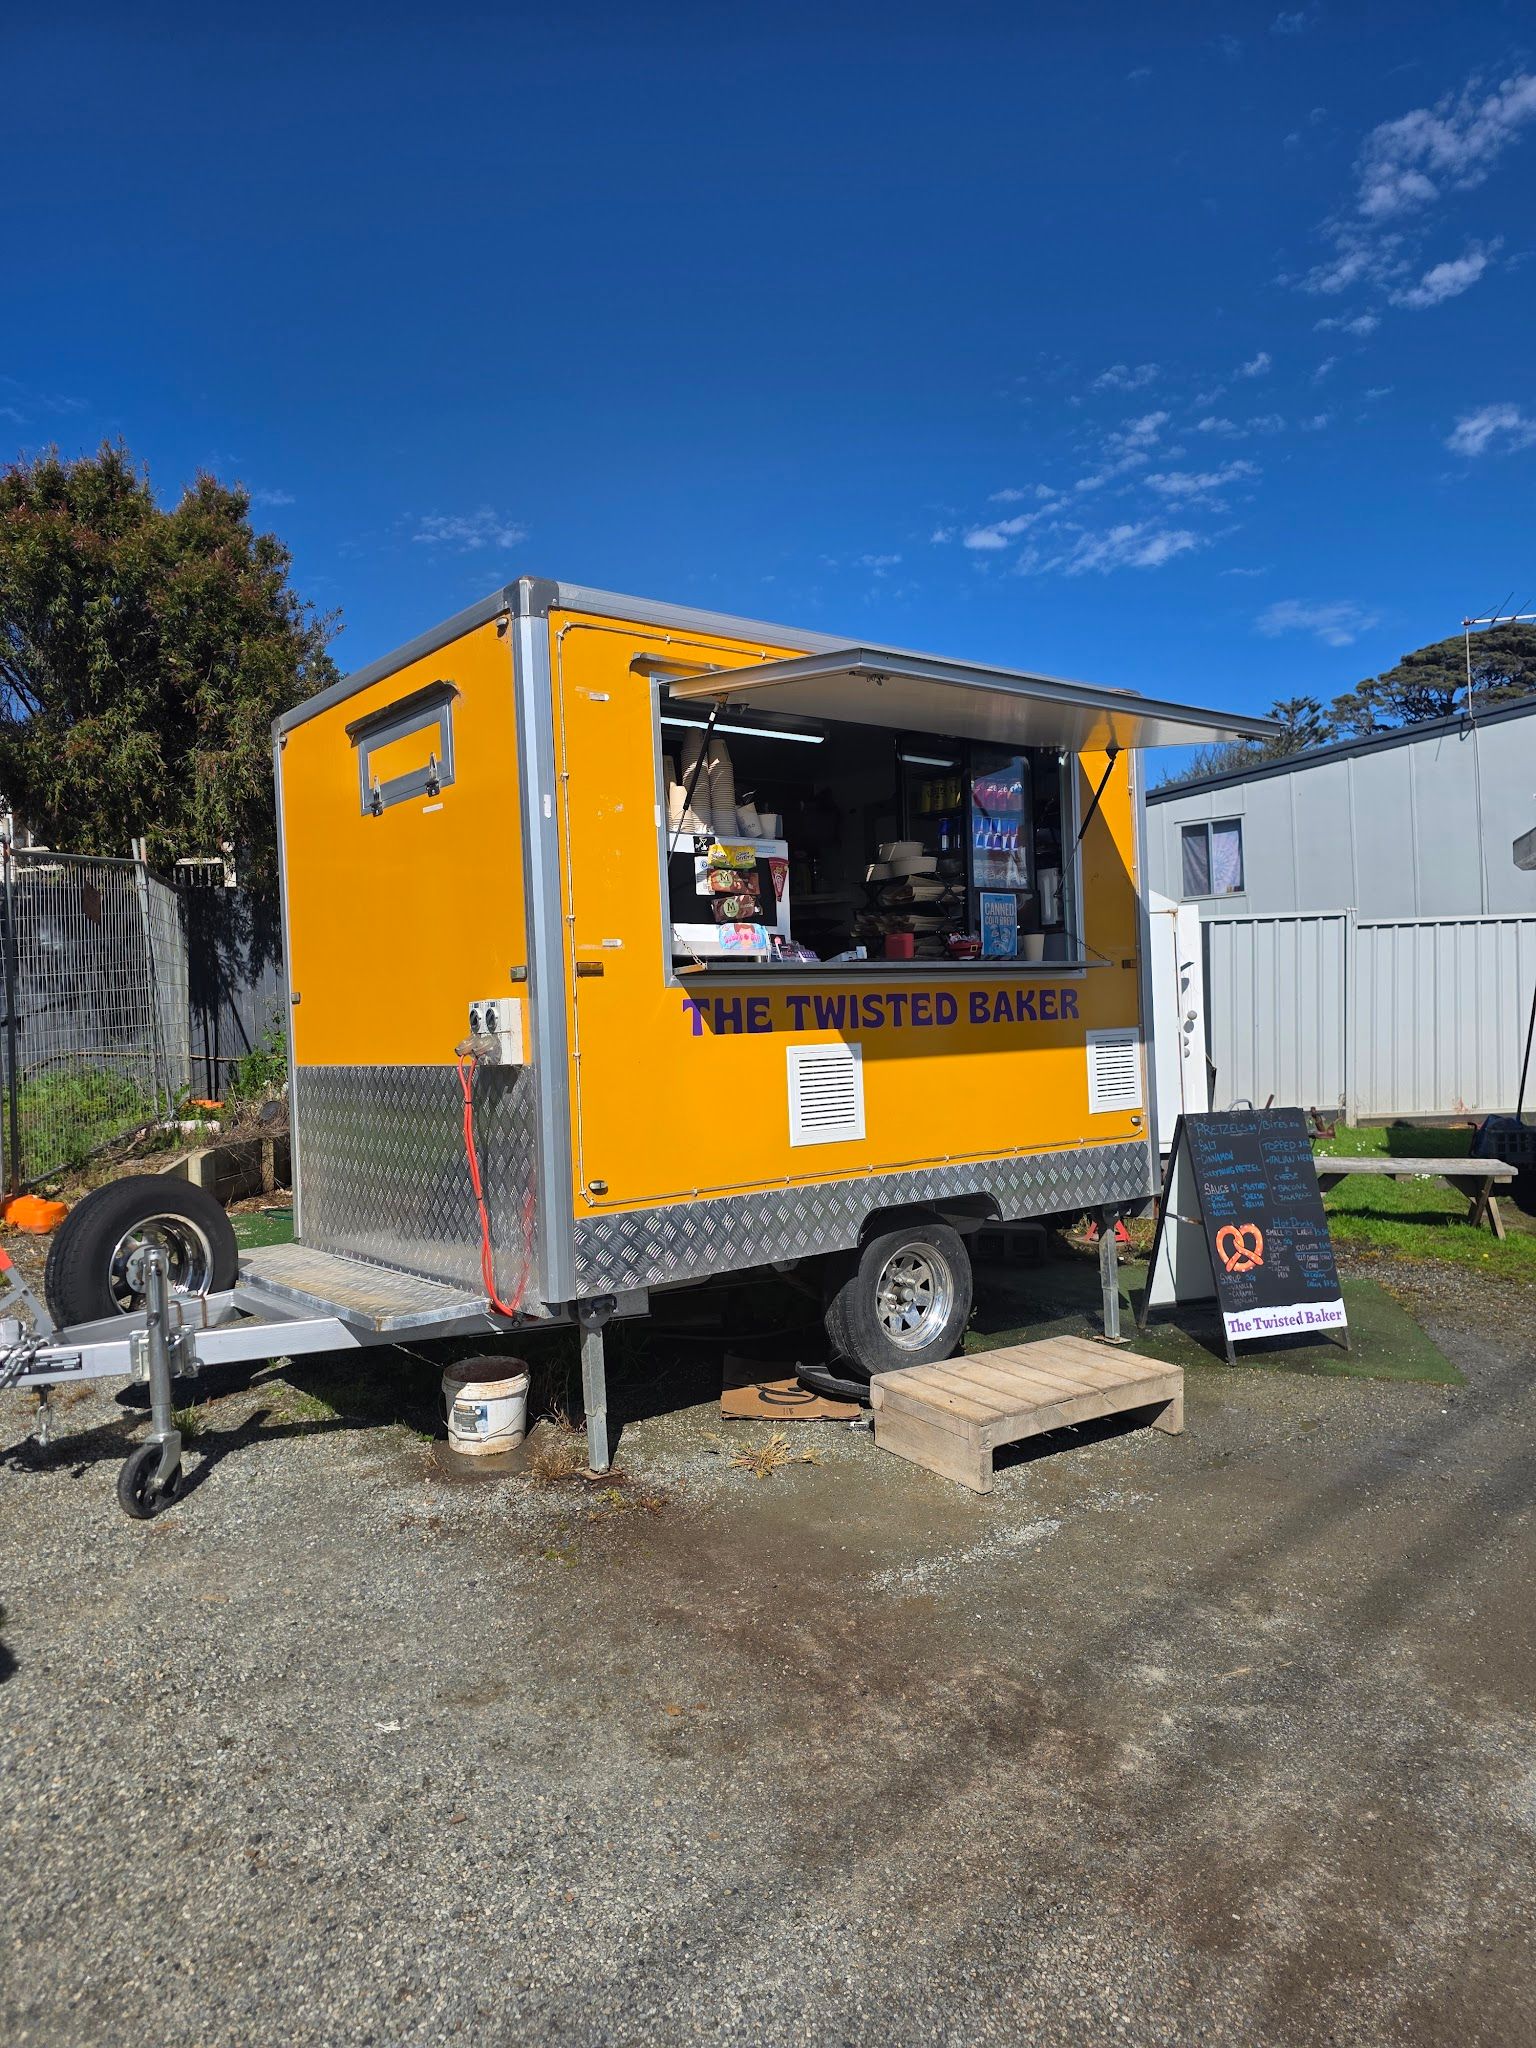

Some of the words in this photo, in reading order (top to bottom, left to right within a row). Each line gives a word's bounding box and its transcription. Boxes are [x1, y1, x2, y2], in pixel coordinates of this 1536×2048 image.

[727, 902, 736, 911] M
[984, 902, 1016, 917] CANNED
[985, 916, 999, 926] COLD
[1001, 916, 1015, 926] BREW
[682, 997, 773, 1037] THE
[786, 992, 959, 1031] TWISTED
[968, 987, 1080, 1025] BAKER
[1194, 1122, 1249, 1137] PRETZELS
[1262, 1120, 1289, 1130] BITES
[1198, 1139, 1217, 1152] SALT
[1262, 1139, 1296, 1151] TOPPED
[1204, 1182, 1230, 1195] SAUCE
[1265, 1228, 1284, 1236] SMALL
[1228, 1319, 1252, 1333] The
[1252, 1311, 1304, 1330] Twisted
[1304, 1309, 1342, 1324] Baker
